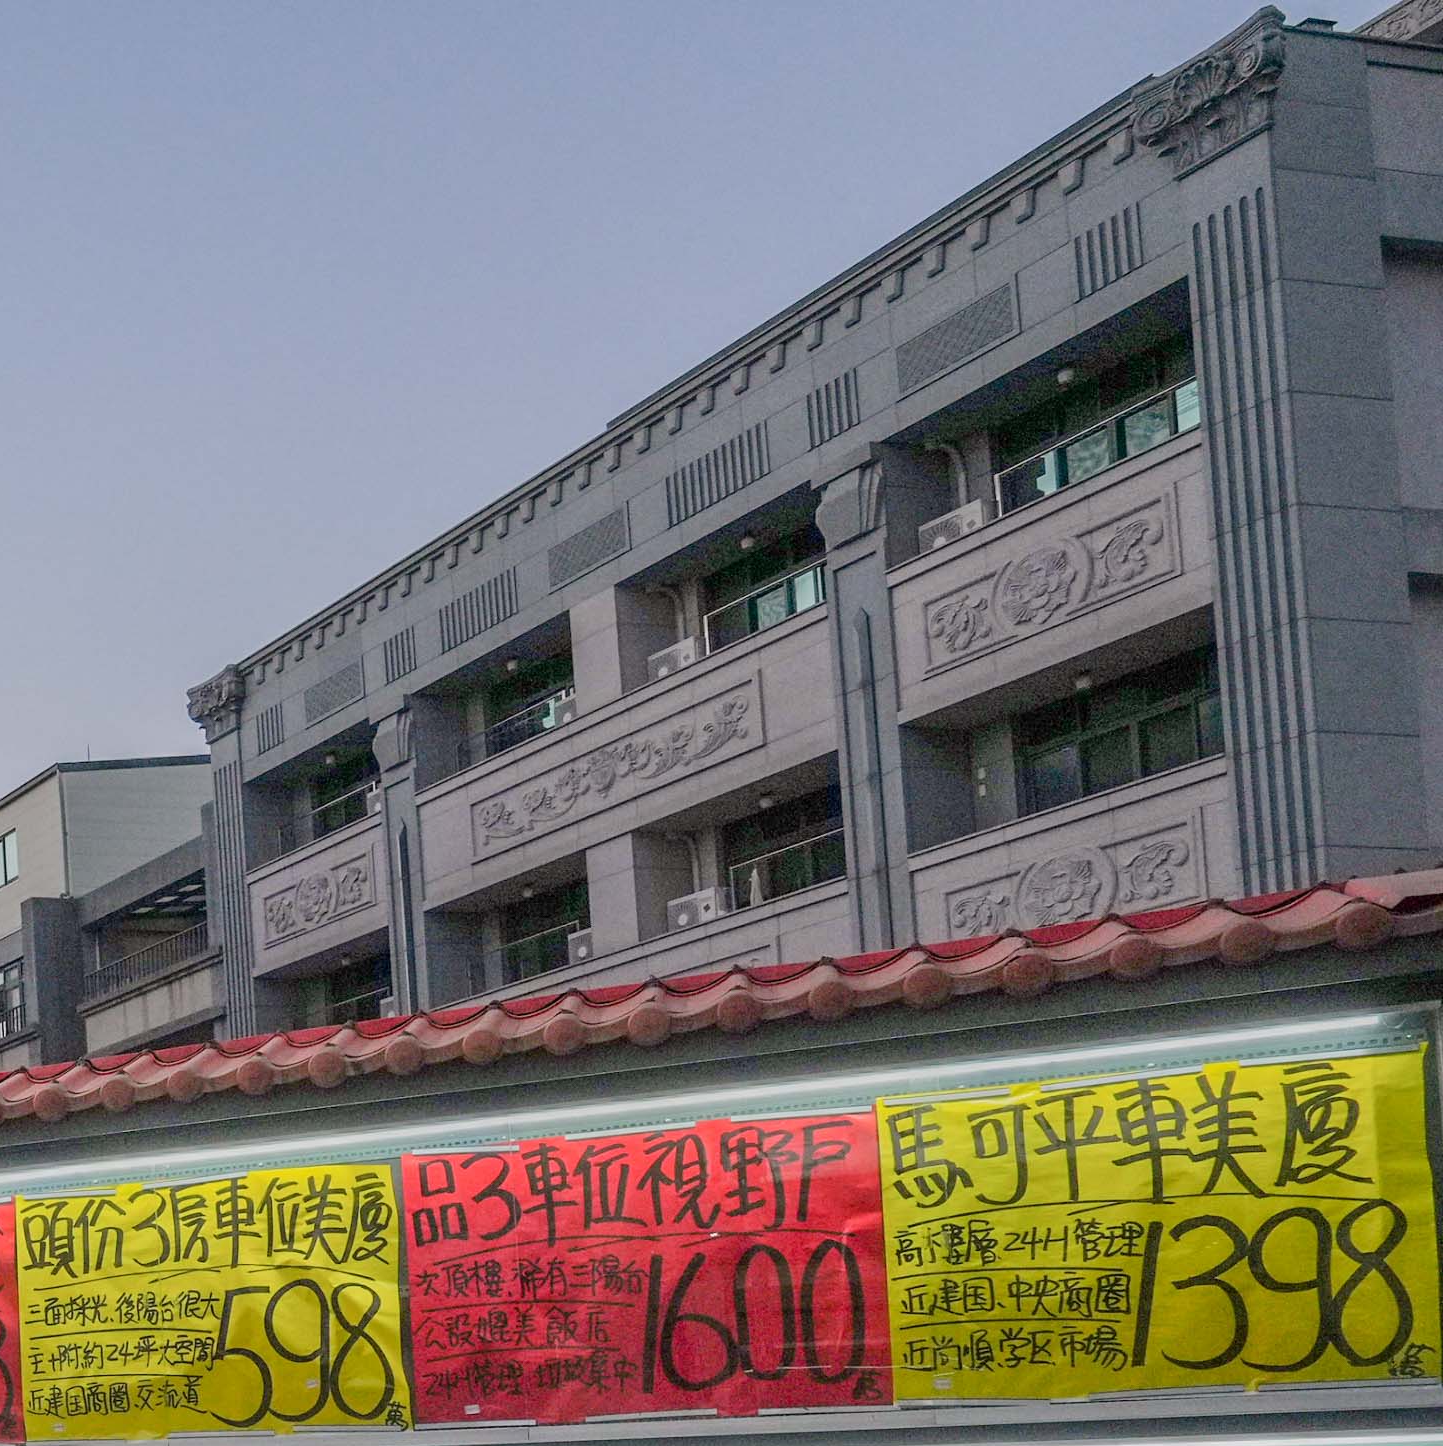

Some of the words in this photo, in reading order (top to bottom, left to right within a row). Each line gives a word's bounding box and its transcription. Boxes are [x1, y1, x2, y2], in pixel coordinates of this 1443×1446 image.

[887, 1063, 1374, 1208] 馬可平車美廈
[21, 1173, 392, 1277] 頭份3房車位美廈
[1131, 1198, 1415, 1373] 1398
[210, 1279, 394, 1427] 598
[385, 1401, 407, 1431] 萬
[643, 1239, 866, 1394] 1600
